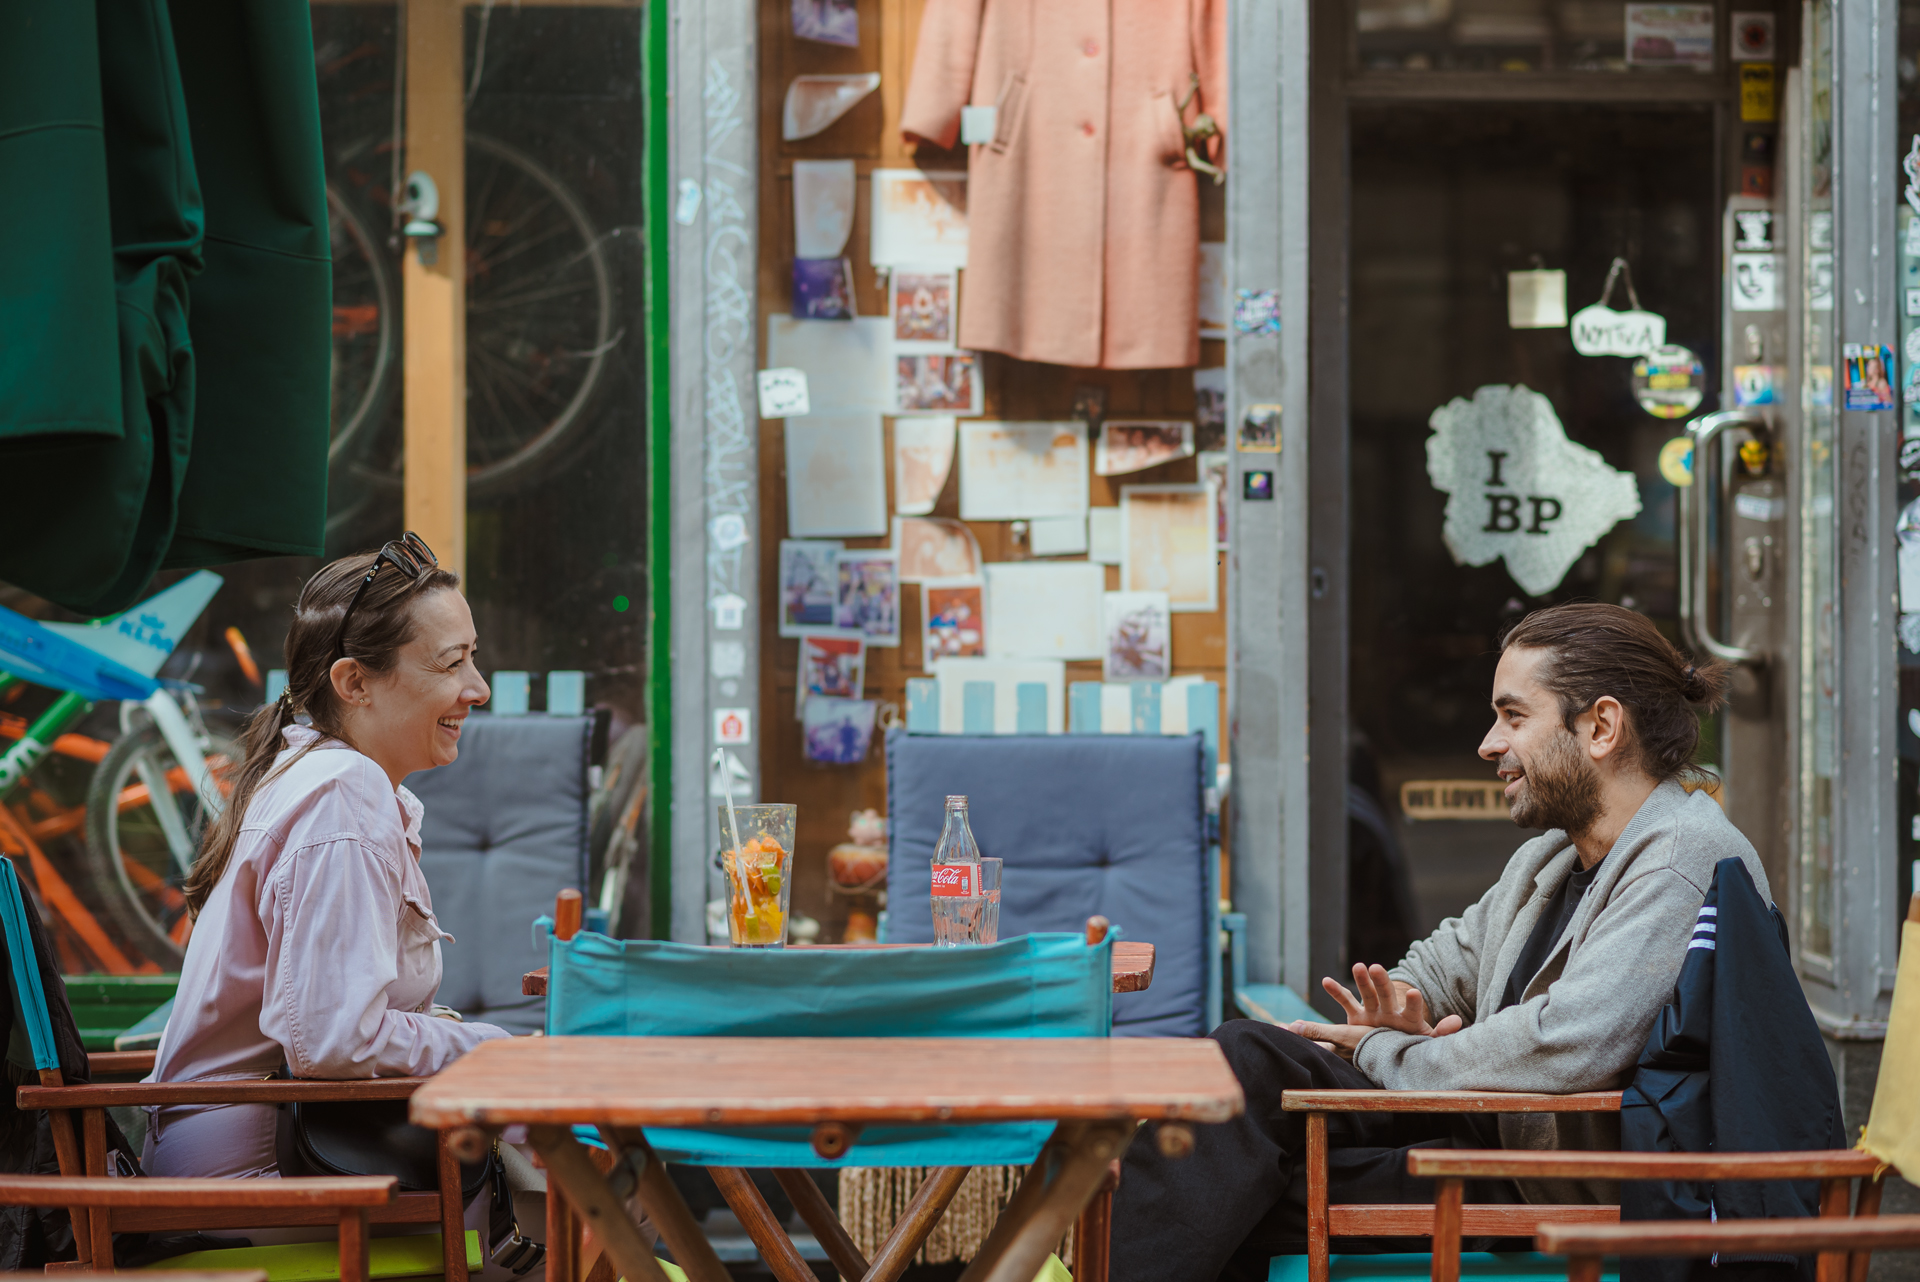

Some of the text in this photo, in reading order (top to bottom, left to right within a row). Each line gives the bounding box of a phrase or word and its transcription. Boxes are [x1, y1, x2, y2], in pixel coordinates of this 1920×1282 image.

[1484, 450, 1508, 487] I
[1481, 493, 1563, 534] BP
[118, 620, 174, 653] KLM
[1442, 789, 1486, 808] LOVE
